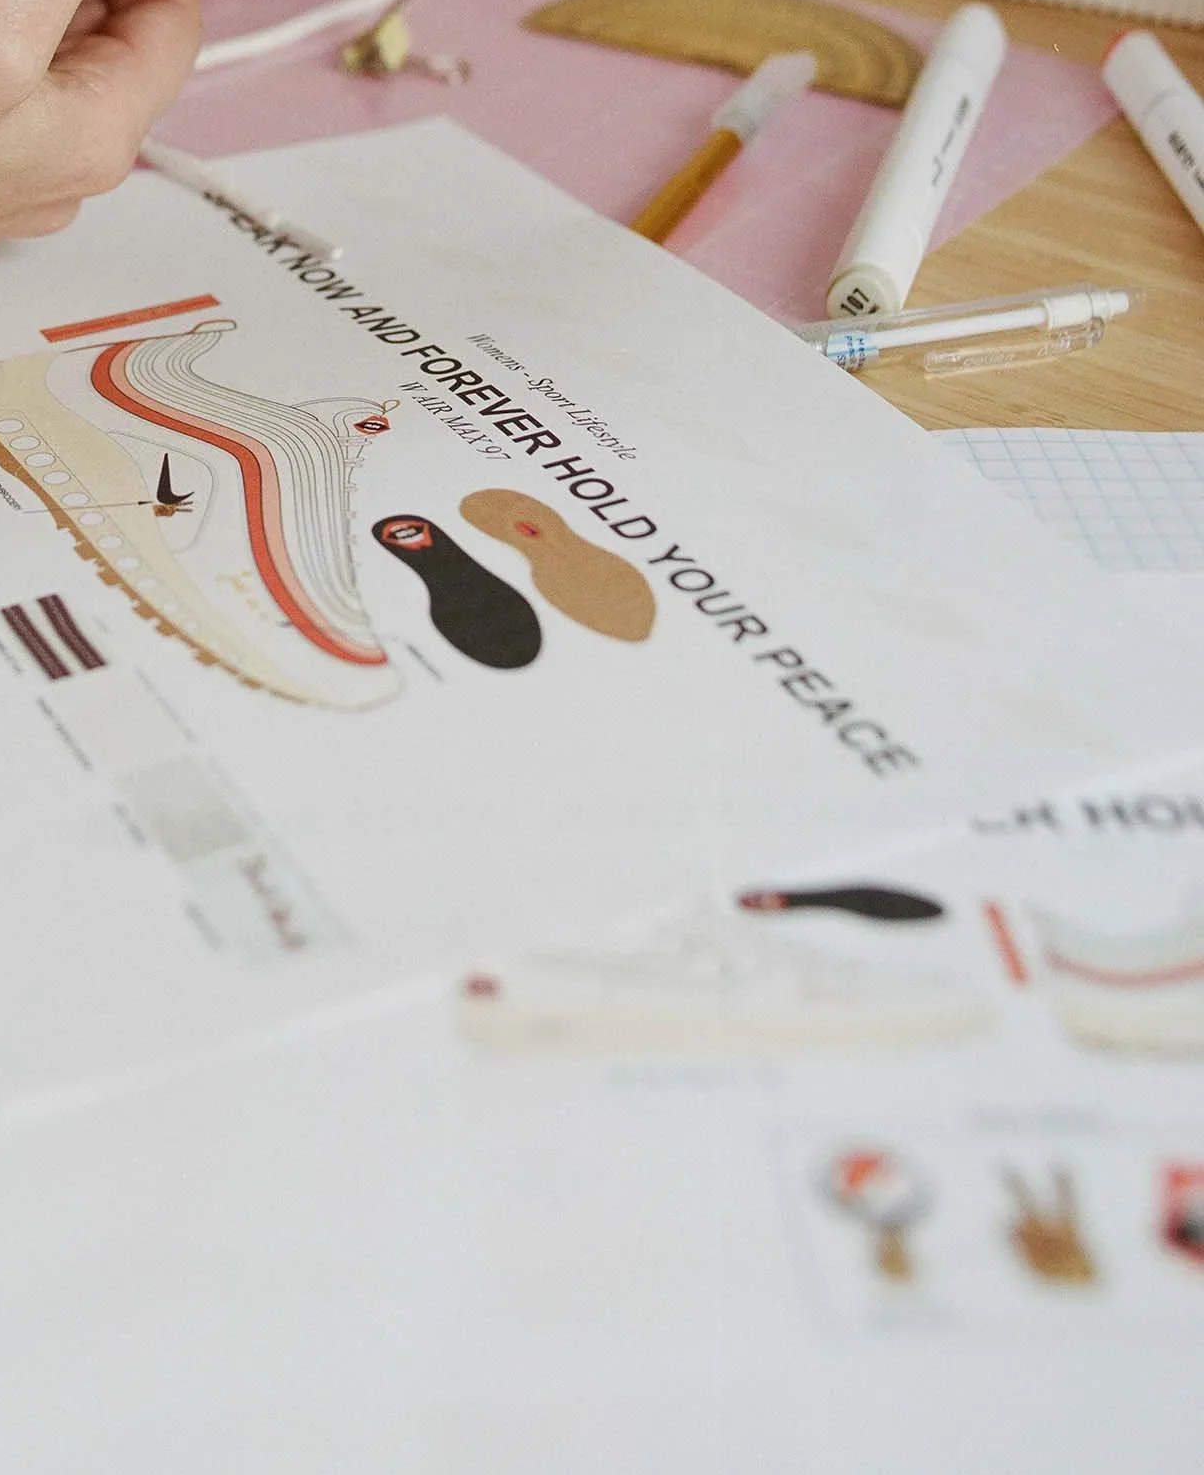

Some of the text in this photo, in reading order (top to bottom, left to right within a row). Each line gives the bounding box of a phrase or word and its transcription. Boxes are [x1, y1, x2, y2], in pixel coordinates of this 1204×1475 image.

[840, 287, 870, 317] 107
[397, 380, 513, 461] W AIR MAX 97
[465, 332, 527, 373] Womens
[527, 377, 577, 410] Sport
[565, 407, 638, 462] Lifestyle
[279, 249, 364, 301] NOW
[338, 305, 421, 345] AND
[400, 343, 562, 456] FOREVER
[541, 455, 658, 540] HOLD
[647, 543, 770, 643] YOUR
[752, 646, 920, 779] PEACE
